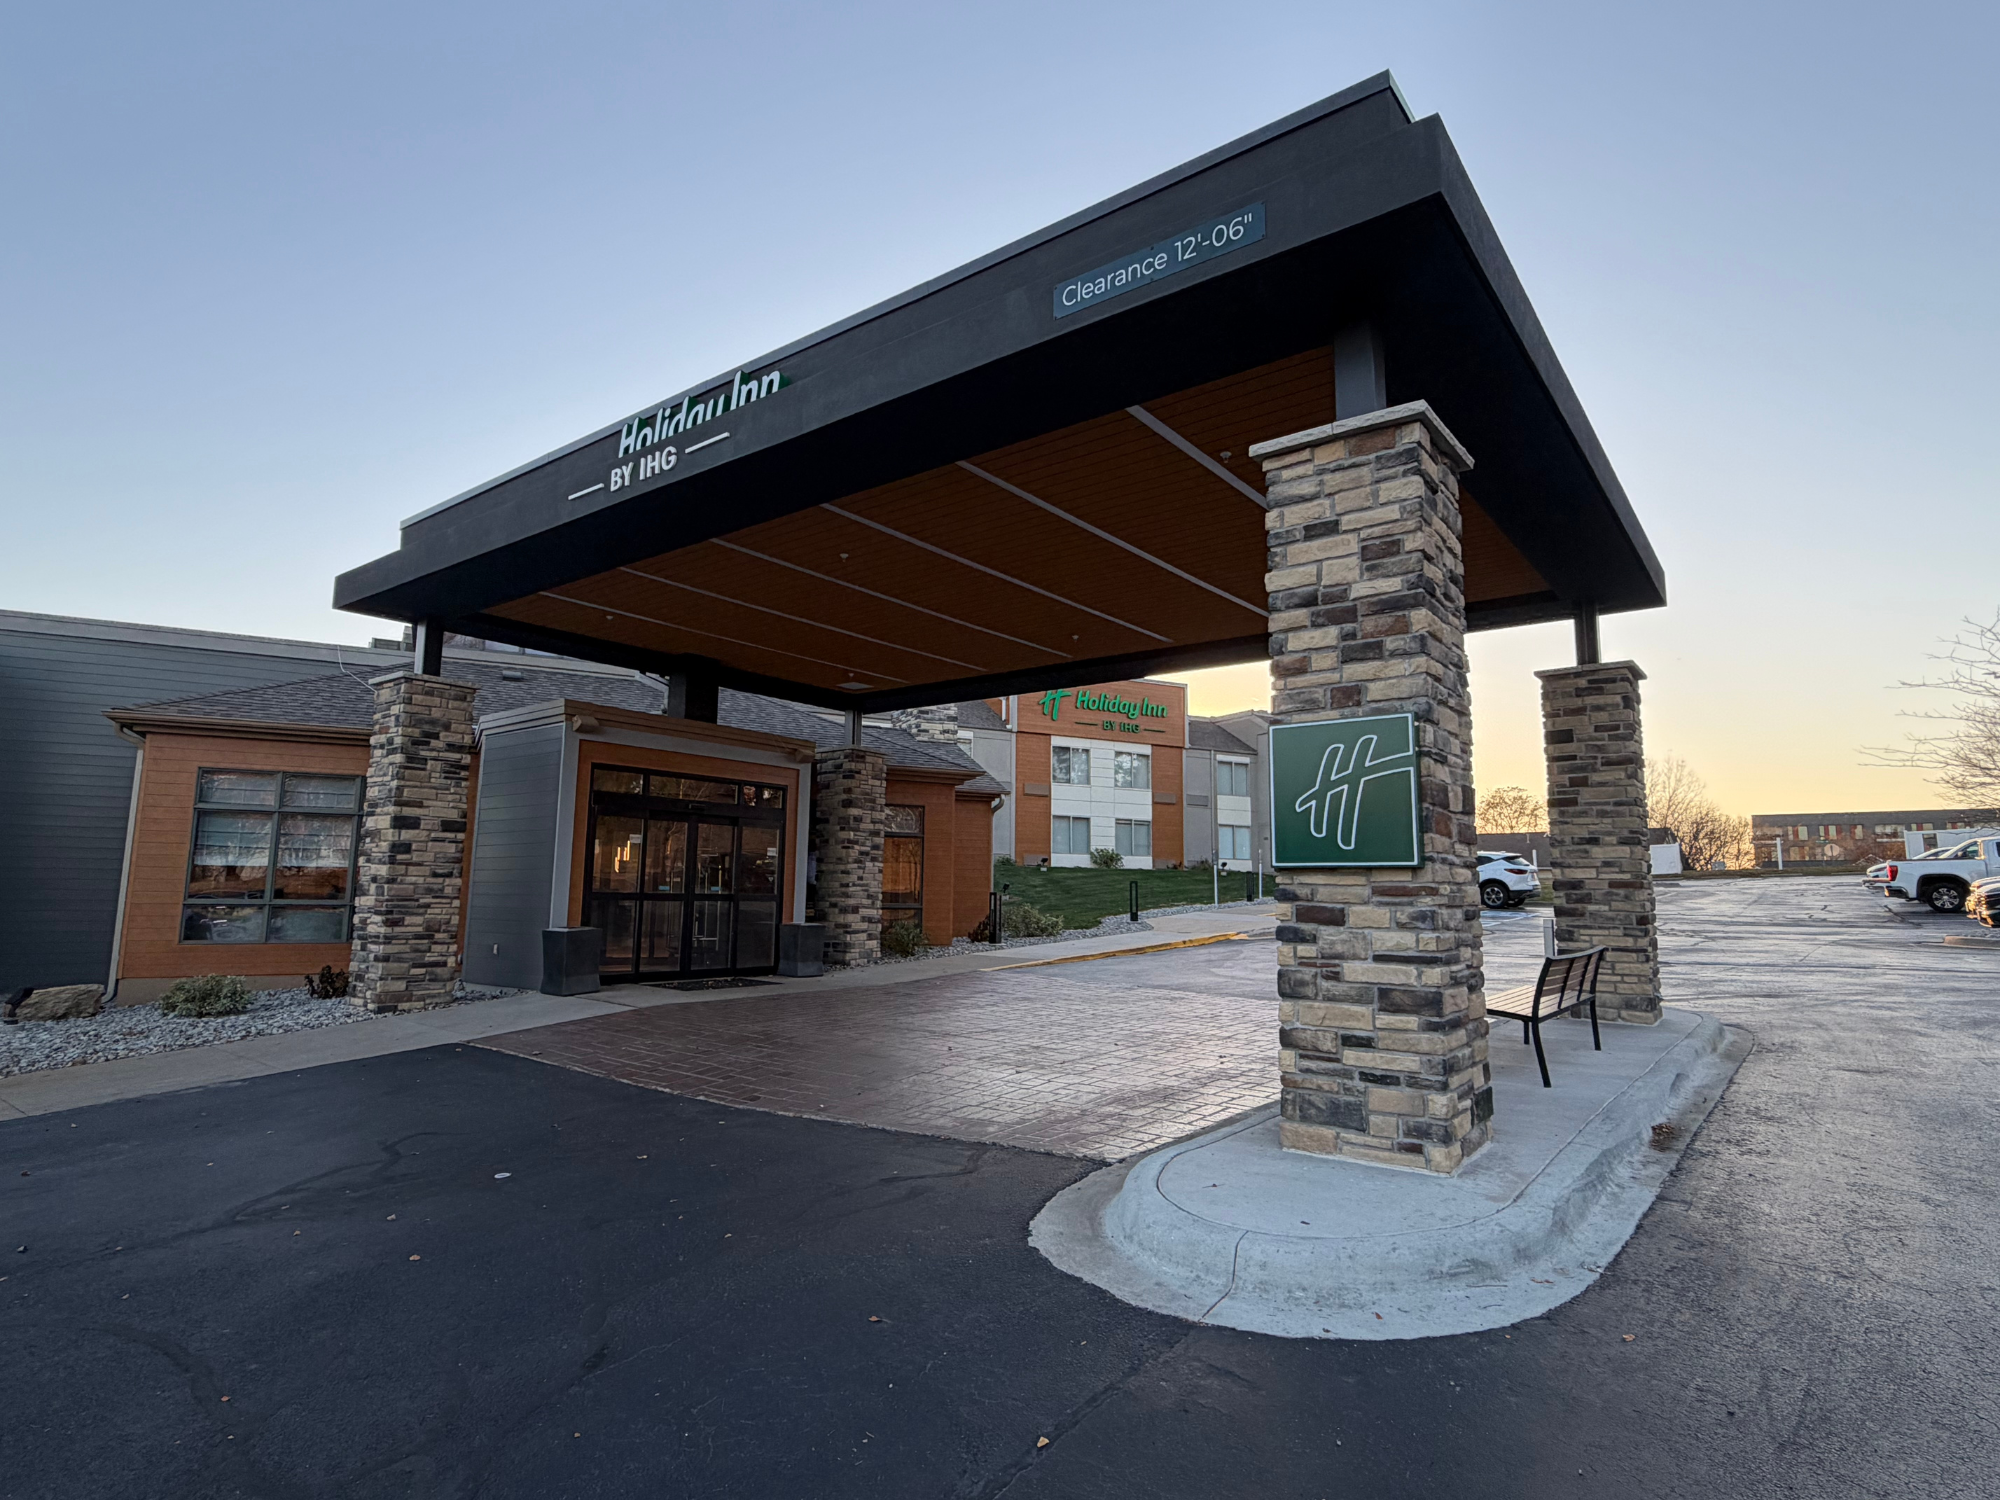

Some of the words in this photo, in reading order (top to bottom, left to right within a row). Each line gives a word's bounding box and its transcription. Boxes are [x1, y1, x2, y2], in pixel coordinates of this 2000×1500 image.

[1062, 252, 1168, 306] Clearance
[730, 370, 781, 411] Inn
[610, 461, 634, 492] BY
[639, 445, 677, 481] IHG
[1076, 689, 1140, 719] Holiday
[1142, 696, 1168, 718] Inn
[1103, 719, 1116, 731] BY
[1120, 721, 1140, 733] IHG
